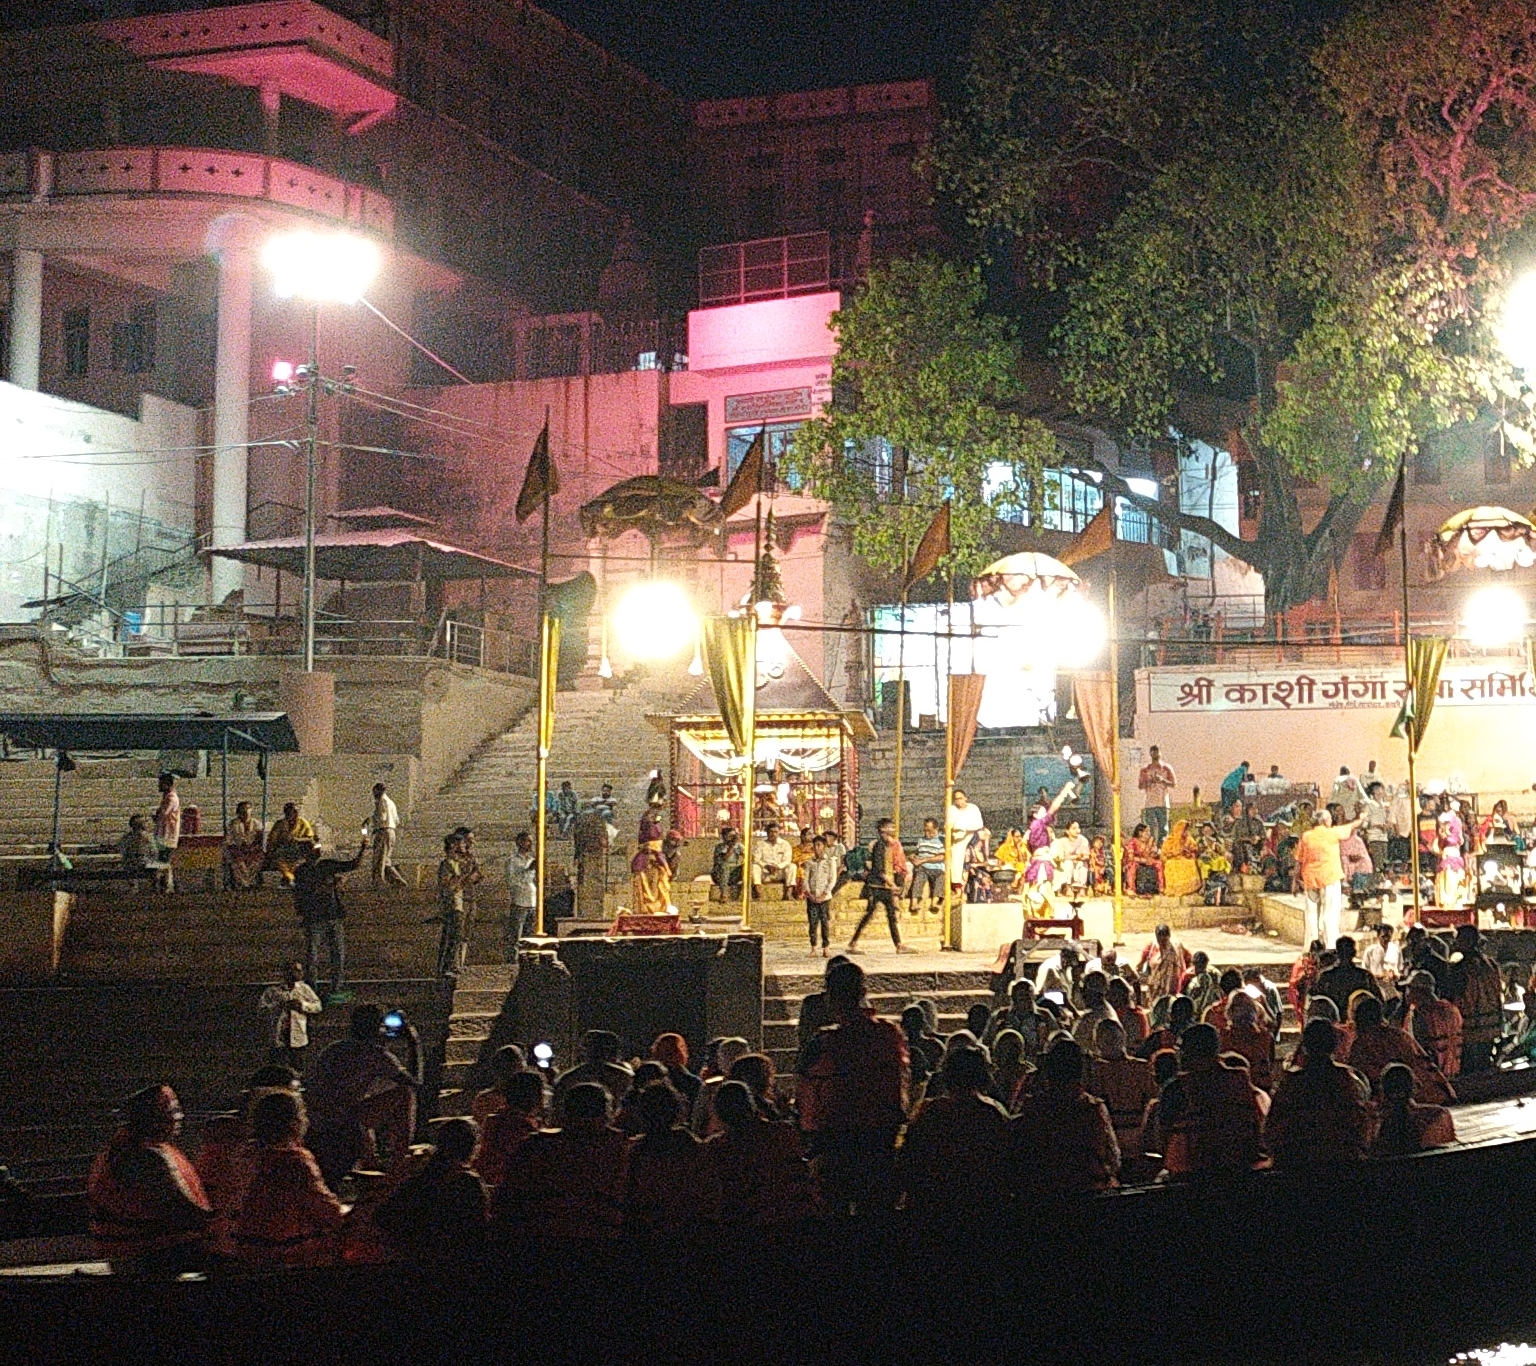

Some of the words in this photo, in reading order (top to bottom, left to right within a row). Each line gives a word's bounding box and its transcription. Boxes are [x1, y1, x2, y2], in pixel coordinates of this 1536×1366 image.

[1177, 676, 1215, 707] श्री
[1223, 675, 1317, 709] काशी
[1321, 676, 1389, 700] गंगा
